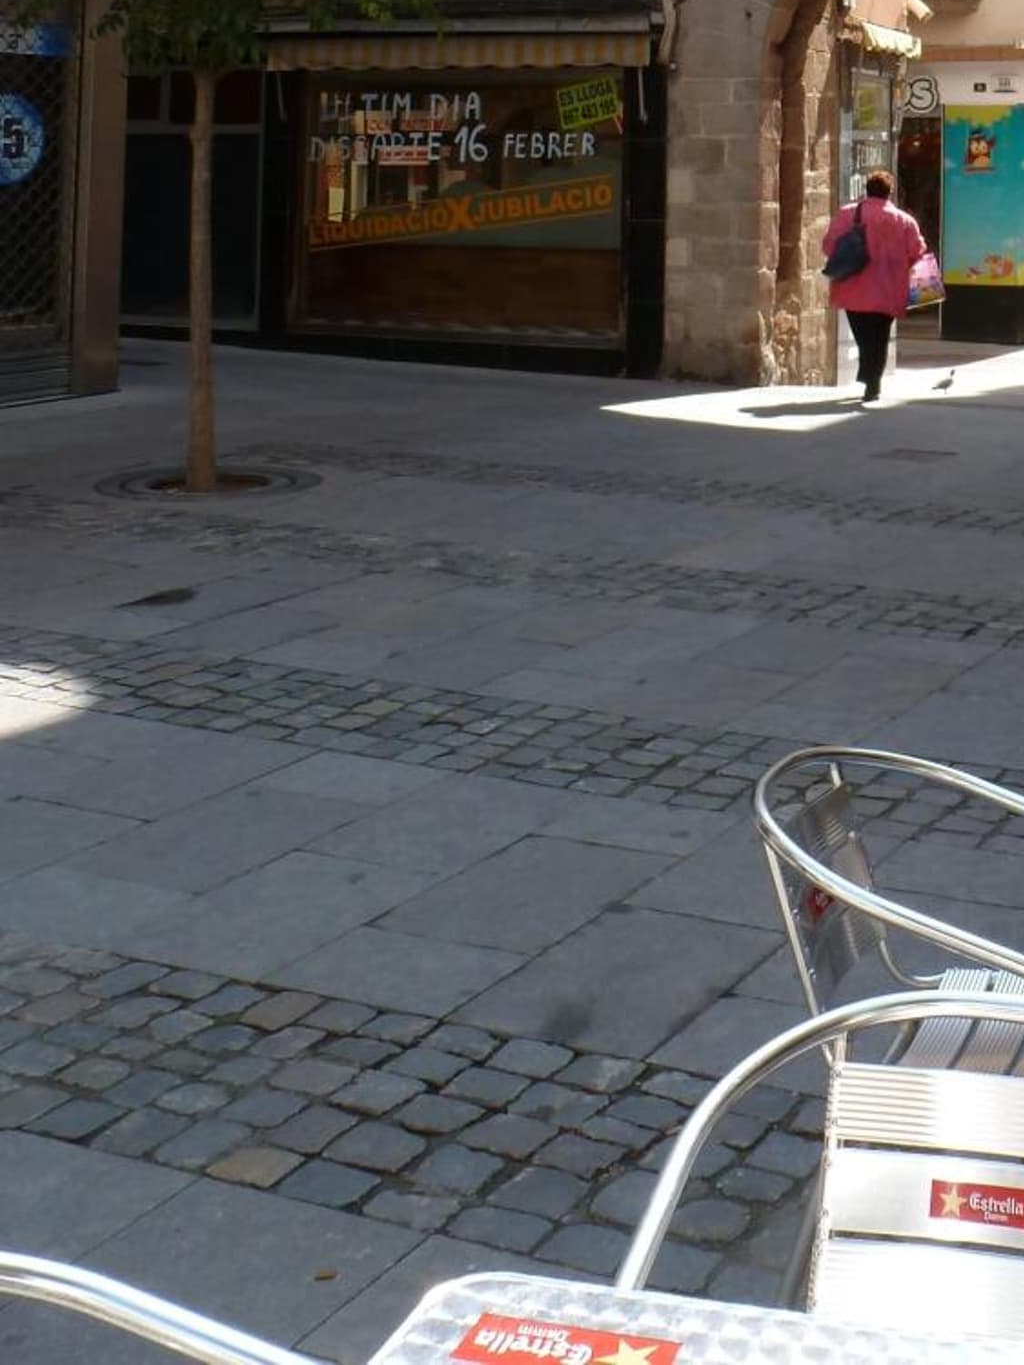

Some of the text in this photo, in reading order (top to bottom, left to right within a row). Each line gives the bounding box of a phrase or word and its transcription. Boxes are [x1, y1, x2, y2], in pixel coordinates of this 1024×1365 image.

[430, 91, 482, 123] DIA
[454, 123, 489, 163] 16
[503, 133, 596, 159] FEBRER
[969, 1191, 1024, 1216] Estrella
[473, 1327, 593, 1365] Estrella
